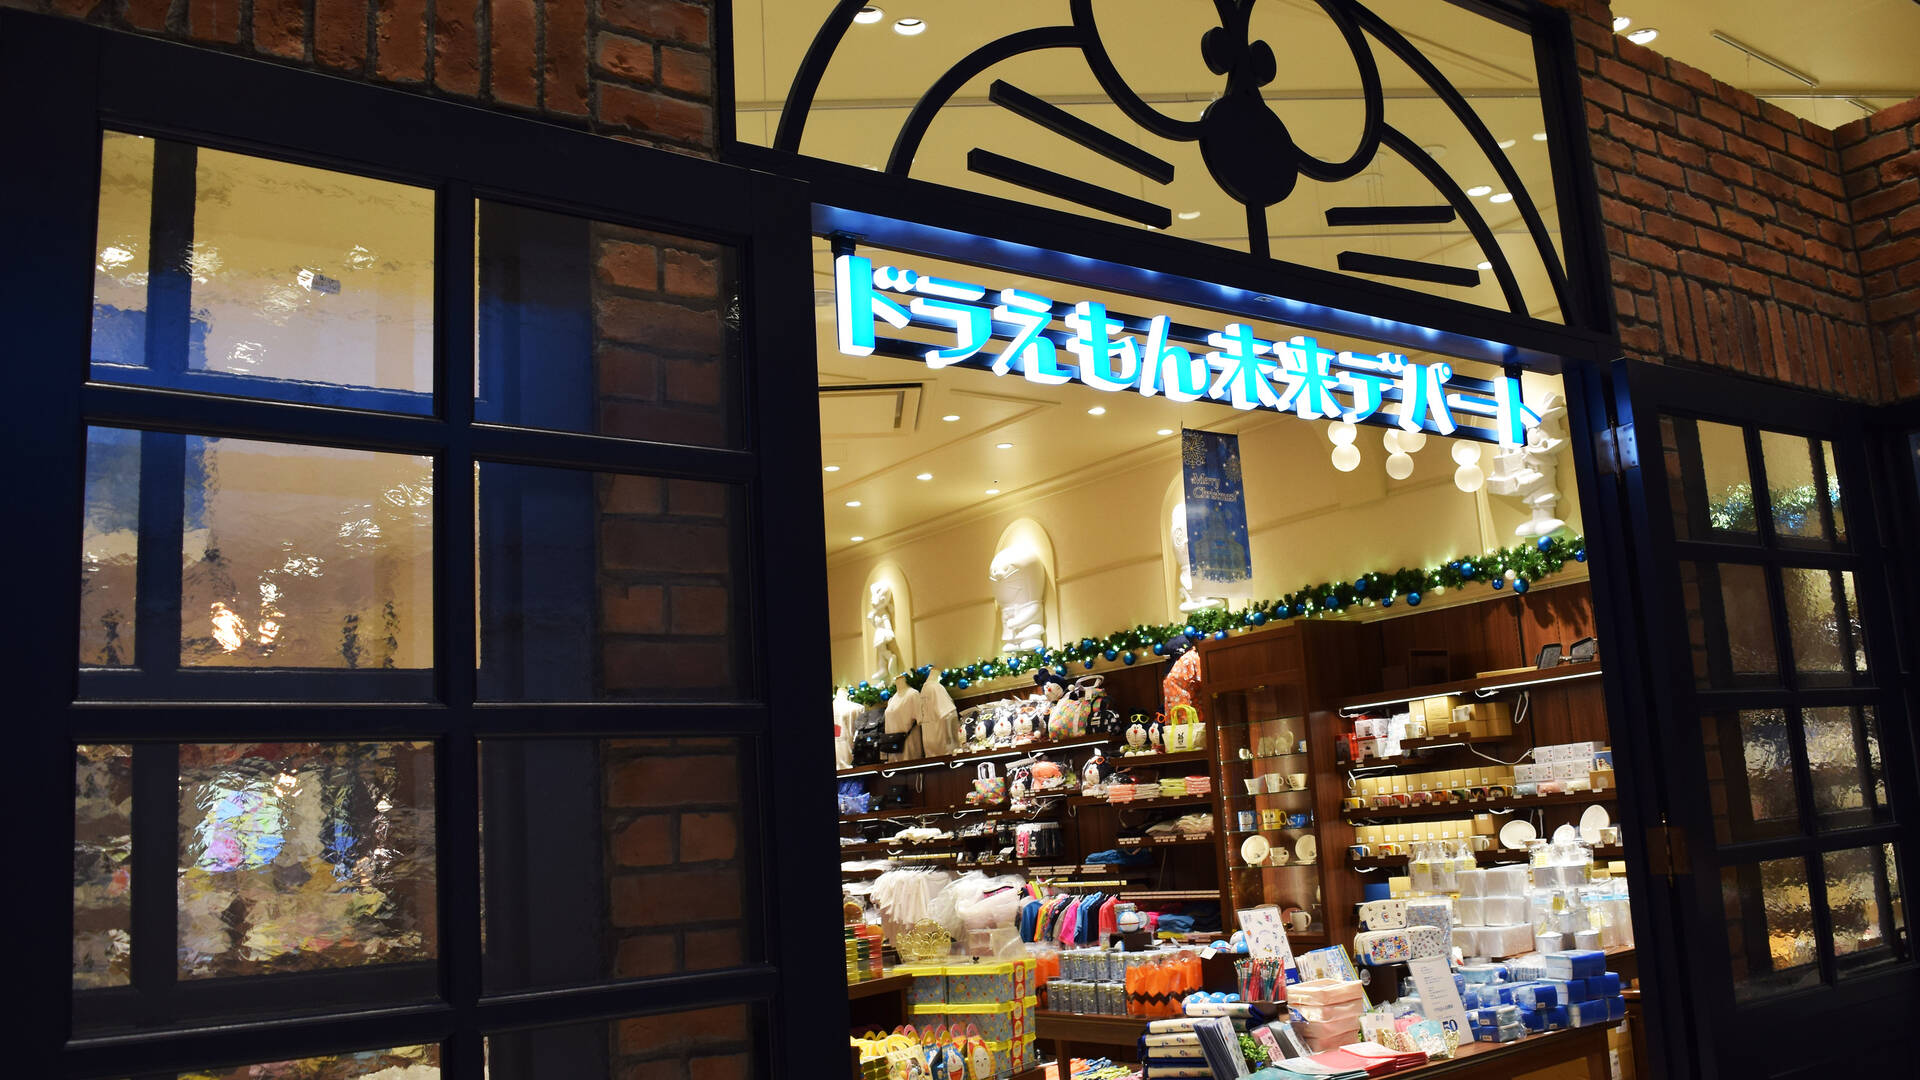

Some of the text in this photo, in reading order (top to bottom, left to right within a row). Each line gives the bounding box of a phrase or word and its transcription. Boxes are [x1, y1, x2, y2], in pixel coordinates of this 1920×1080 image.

[836, 254, 1542, 448] ドラえもん未来デパート
[1191, 472, 1221, 489] Merry
